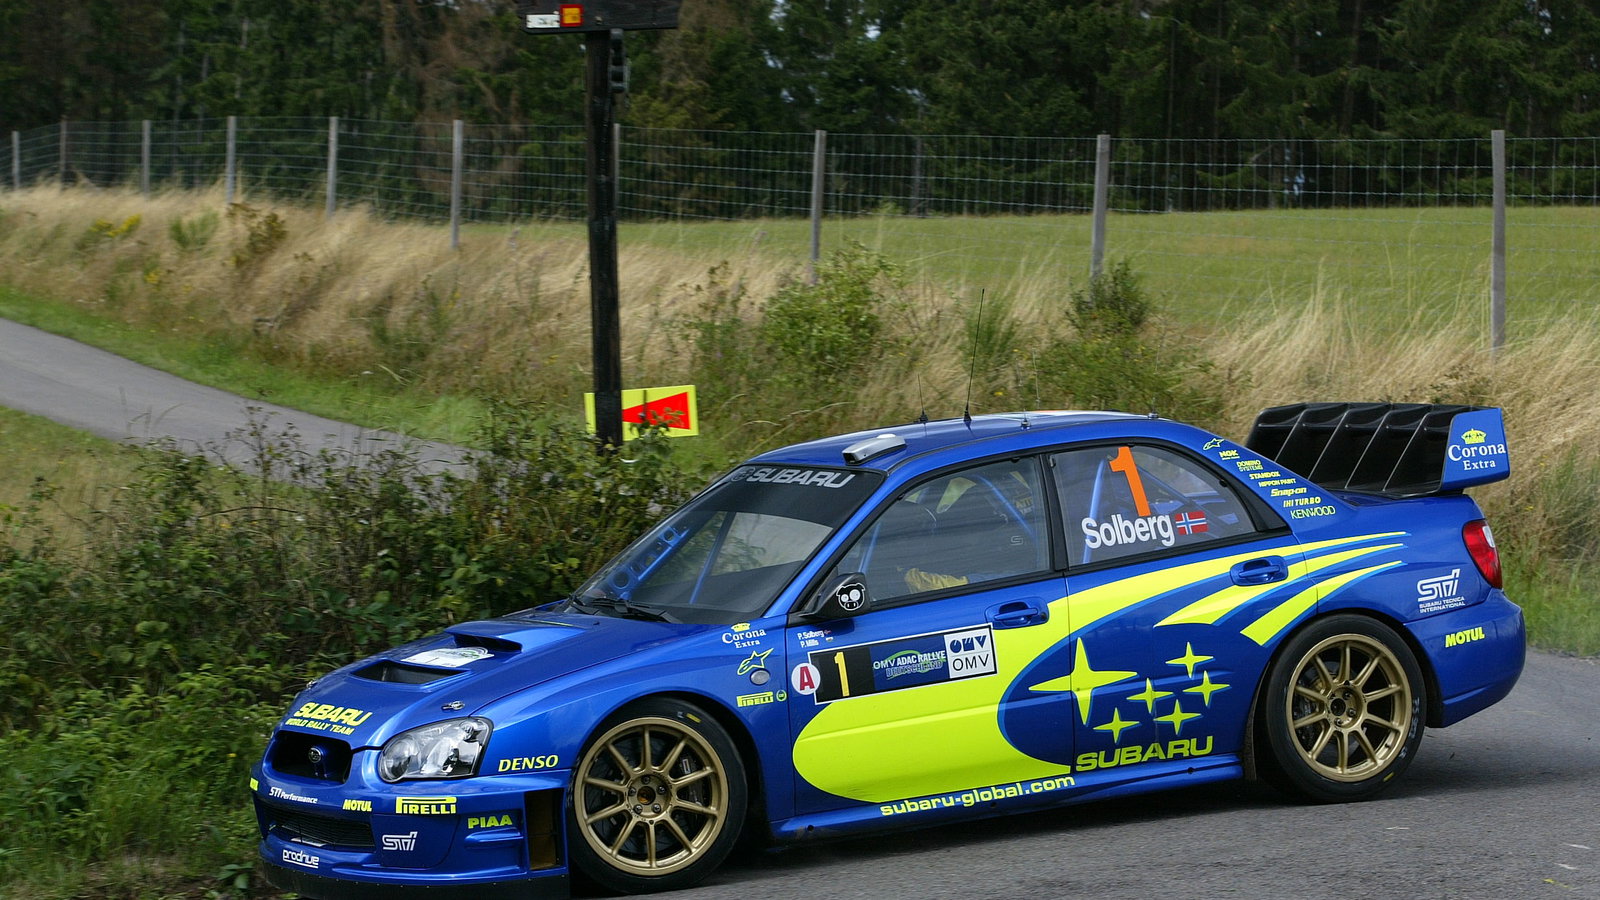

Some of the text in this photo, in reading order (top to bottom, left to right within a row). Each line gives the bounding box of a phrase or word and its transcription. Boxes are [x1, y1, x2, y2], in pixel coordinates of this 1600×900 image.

[1448, 443, 1506, 462] Corona
[1463, 460, 1497, 471] Extra
[747, 467, 855, 488] SUBARU
[1108, 446, 1151, 517] 1
[1249, 471, 1281, 480] STANDOX
[1270, 487, 1307, 497] Snap-on
[1294, 496, 1322, 507] TURBO
[1290, 505, 1336, 520] KENWOOD
[1081, 514, 1175, 549] Solberg
[1419, 596, 1465, 608] SUBARU TECNICA
[1419, 602, 1466, 614] INTERNATIONAL
[721, 628, 767, 644] Corona
[735, 638, 760, 649] Extra
[1445, 627, 1486, 648] MOTUL
[872, 650, 947, 670] OMV ADAC RALLYE
[952, 653, 990, 671] OMV
[800, 665, 815, 691] A
[834, 651, 850, 698] 1
[293, 702, 373, 727] SUBARU
[285, 718, 356, 736] WORLD RALLY TEAM
[498, 754, 559, 772] DENSO
[1075, 735, 1214, 773] SUBARU
[880, 774, 1075, 816] subaru-global.com
[342, 799, 373, 812] MOTUL
[395, 796, 457, 815] PIRELLI
[467, 814, 513, 829] PIAA
[282, 849, 320, 869] prodrive
